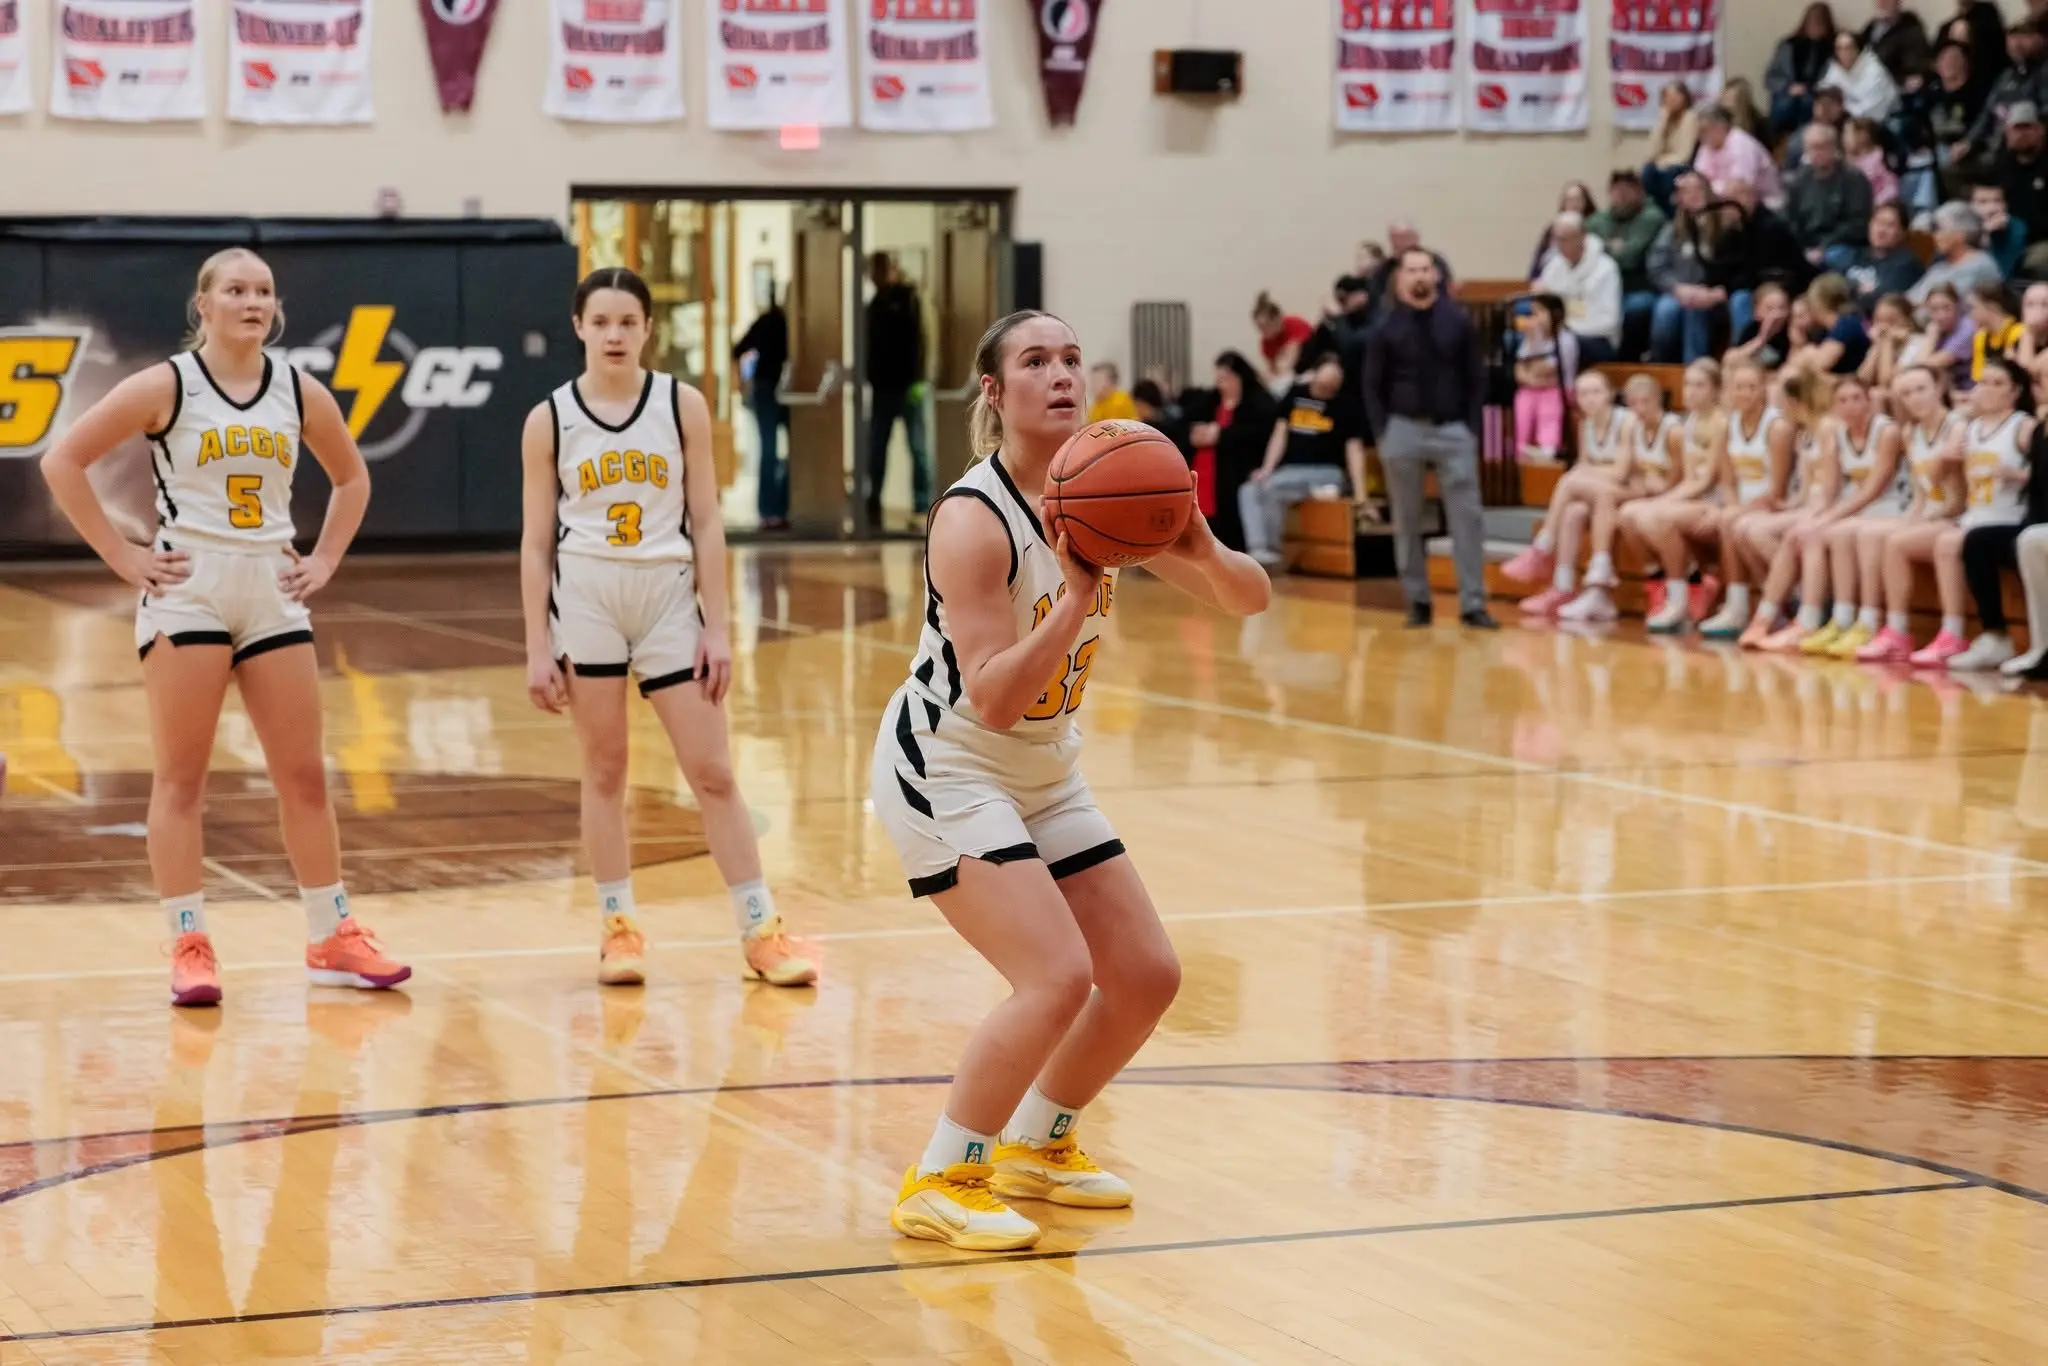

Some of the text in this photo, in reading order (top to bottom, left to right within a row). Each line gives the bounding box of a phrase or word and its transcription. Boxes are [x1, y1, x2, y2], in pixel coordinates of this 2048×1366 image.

[197, 423, 293, 469] ACGC
[577, 449, 669, 497] ACGC
[226, 474, 264, 529] 5
[606, 501, 643, 547] 3
